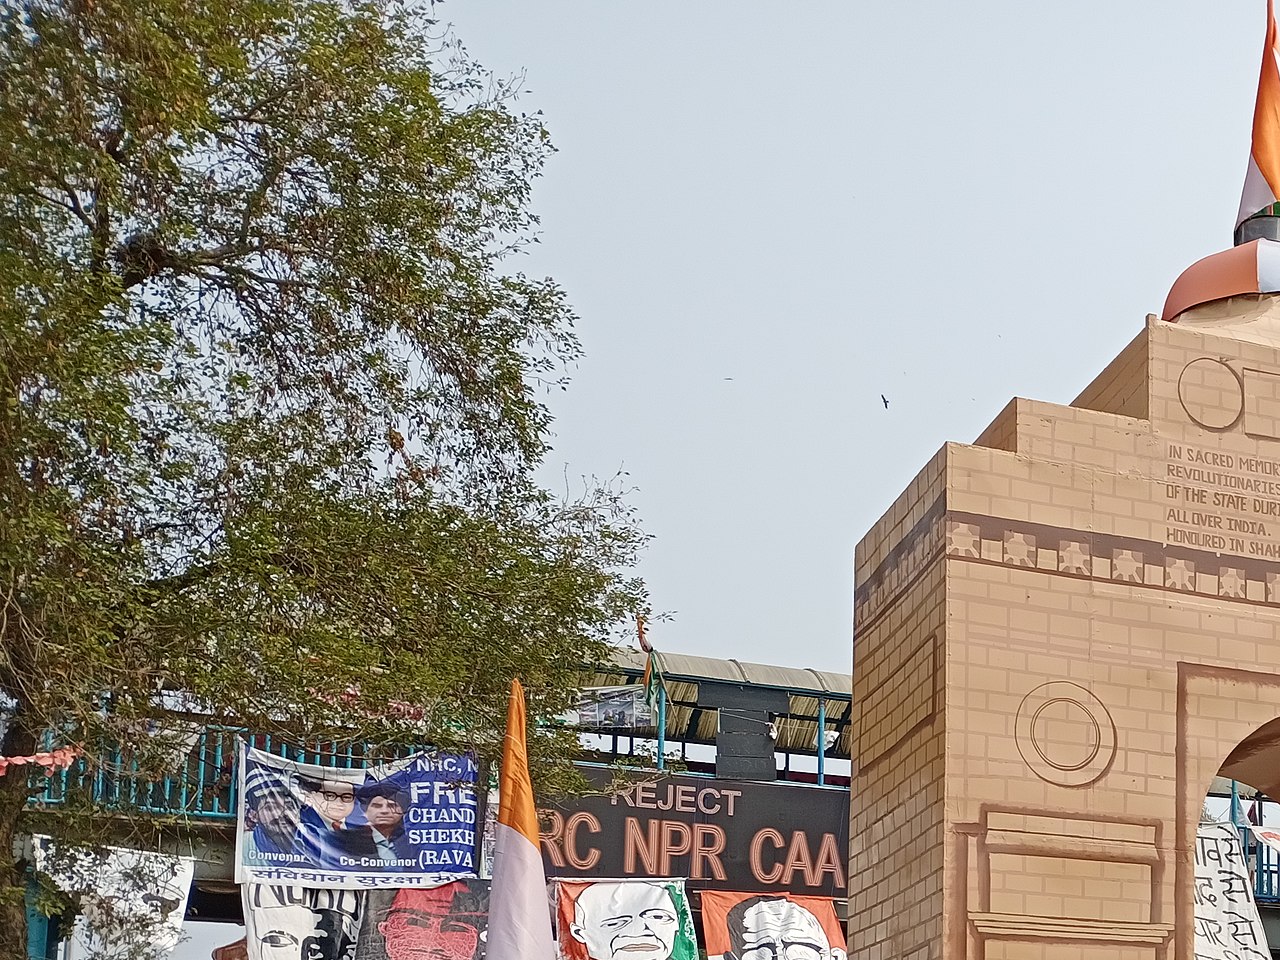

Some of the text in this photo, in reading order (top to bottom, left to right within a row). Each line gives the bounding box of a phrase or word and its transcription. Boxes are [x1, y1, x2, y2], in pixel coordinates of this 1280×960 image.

[1169, 444, 1182, 460] IN
[1187, 448, 1234, 469] SACRED
[1166, 484, 1181, 499] OF
[1183, 487, 1208, 504] THE
[1213, 492, 1247, 512] STATE
[1167, 508, 1272, 537] ALL OVER INDIA.
[1166, 526, 1226, 549] HONOURED
[1229, 537, 1245, 553] IN
[610, 782, 742, 817] REJECT
[248, 850, 306, 863] Convenor
[339, 856, 417, 867] Co-Convenor
[537, 809, 847, 889] RC NPR CAA
[250, 869, 347, 885] संविधान
[355, 874, 421, 887] सुरक्षा
